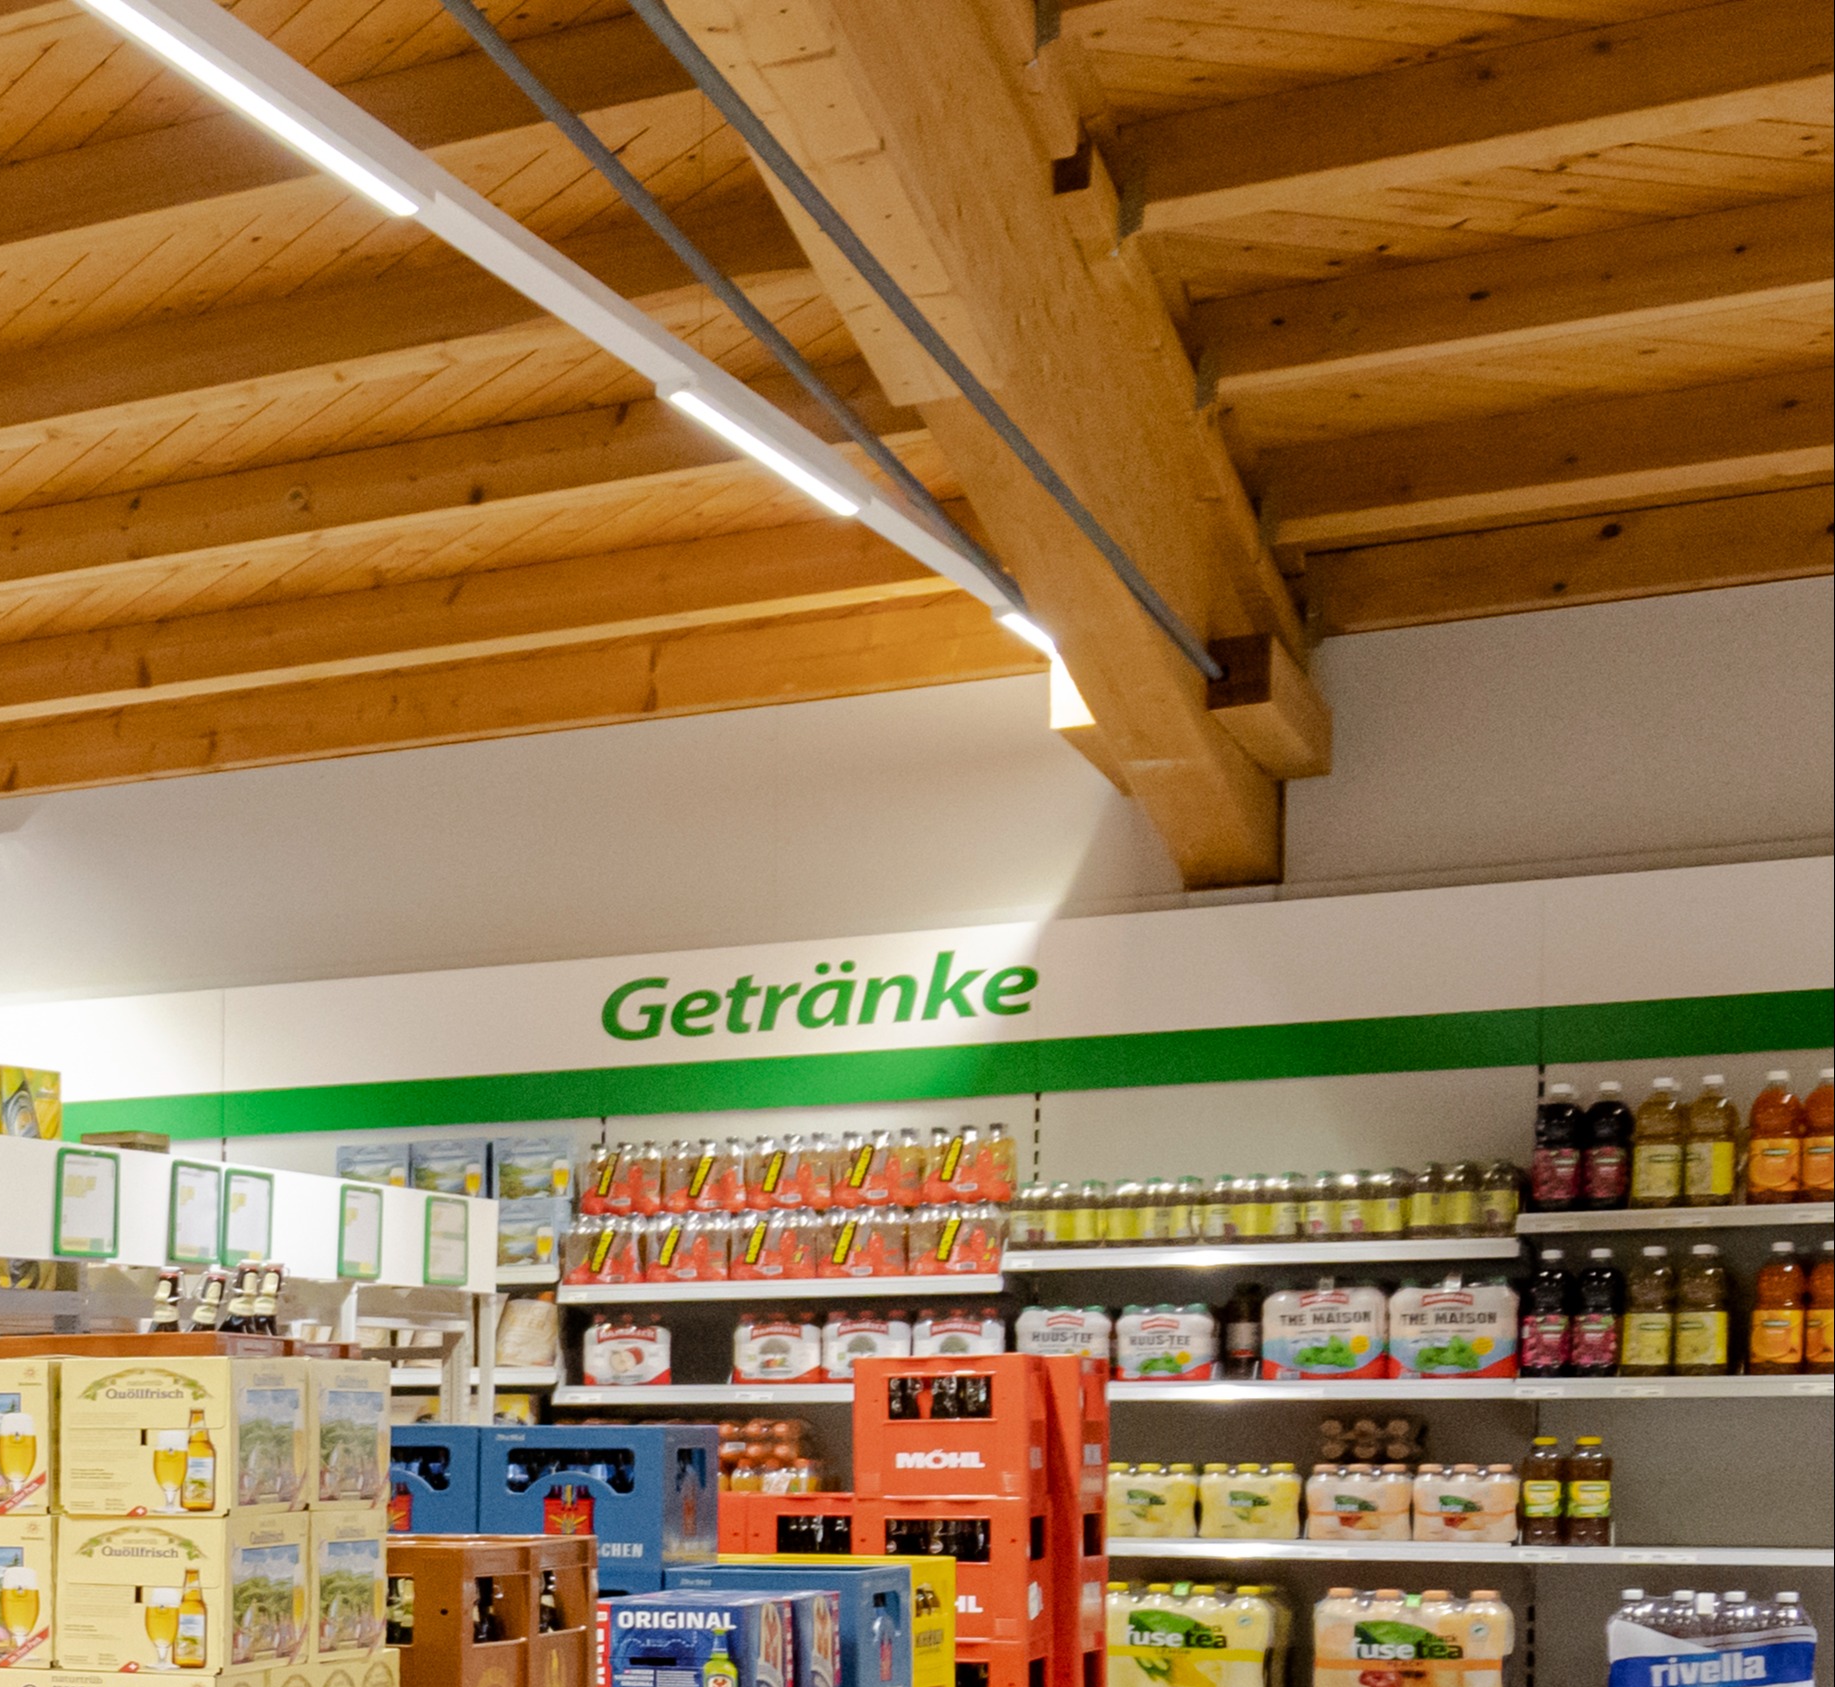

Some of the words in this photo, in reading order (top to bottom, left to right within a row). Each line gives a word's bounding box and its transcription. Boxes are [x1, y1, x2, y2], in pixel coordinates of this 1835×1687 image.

[601, 950, 1039, 1043] Getränke
[1280, 1313, 1307, 1326] THE
[1312, 1310, 1372, 1326] MAISON
[105, 1387, 185, 1401] Quöllfrisch
[895, 1450, 985, 1469] MÖHL
[101, 1545, 179, 1560] Quöllfrisch
[617, 1610, 737, 1631] ORIGINAL
[1650, 1651, 1767, 1687] rivella
